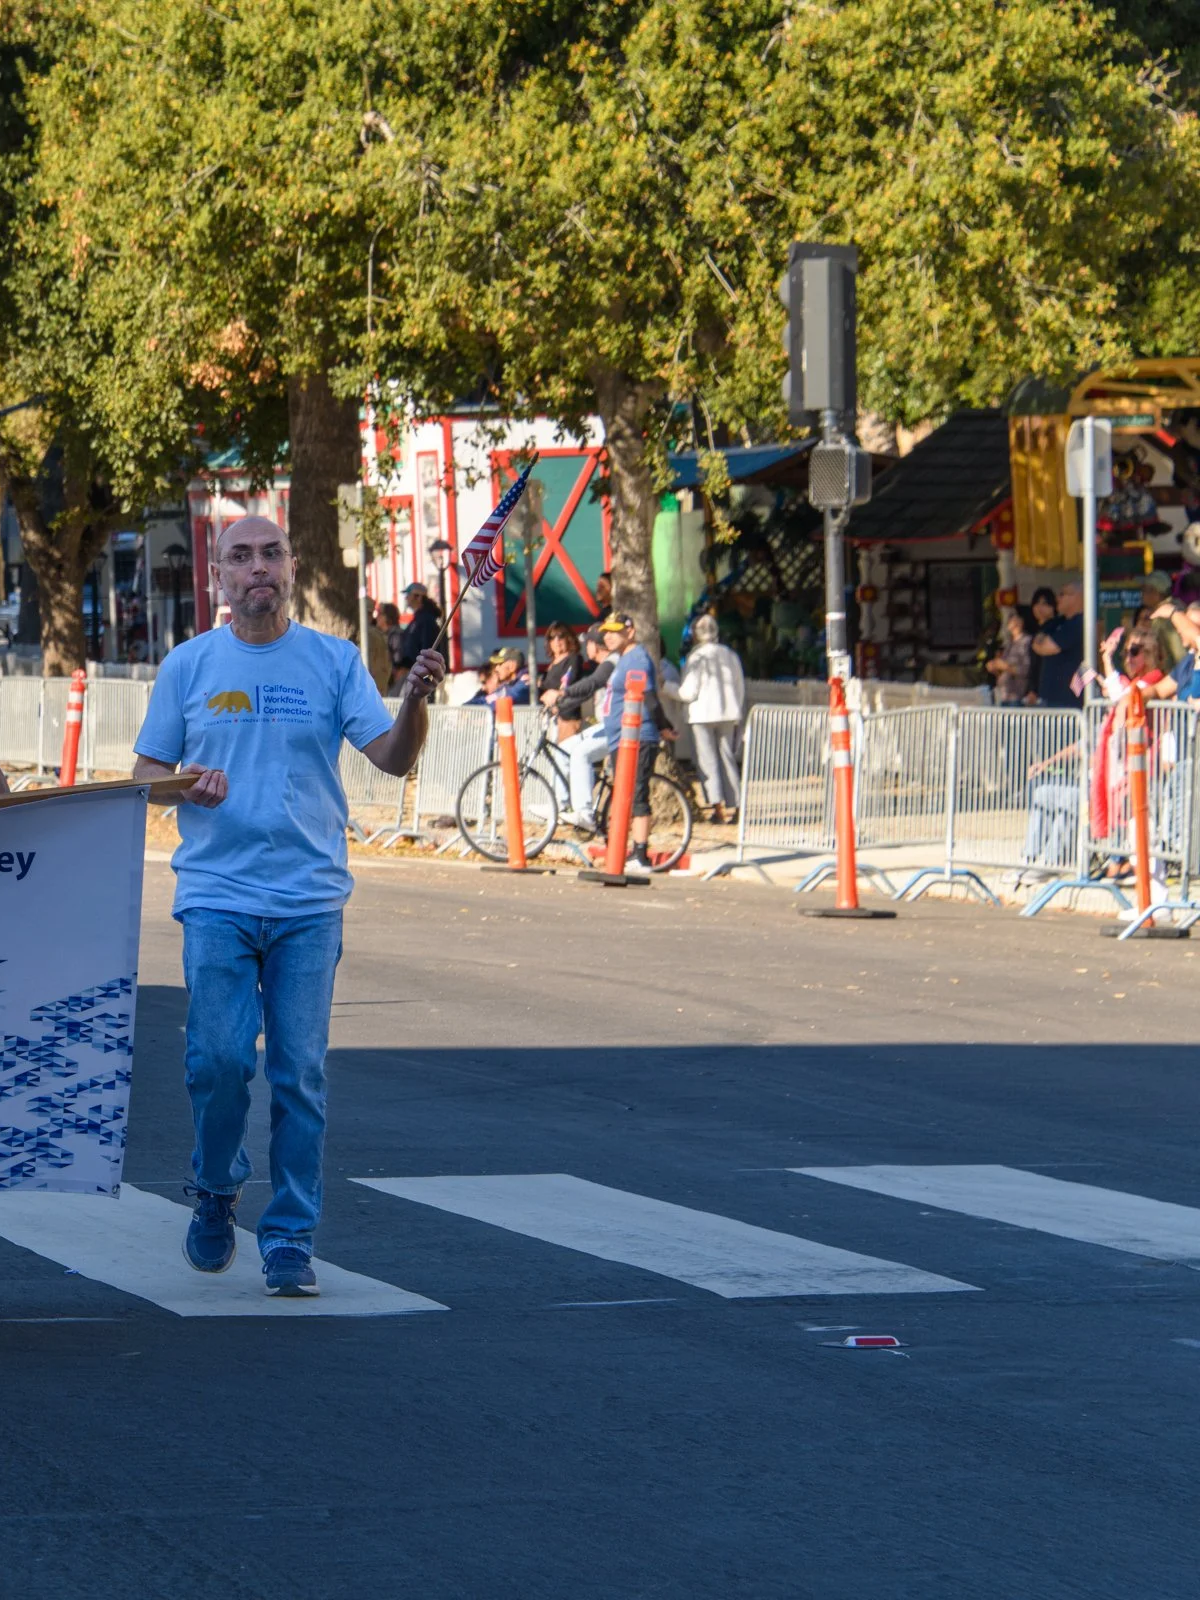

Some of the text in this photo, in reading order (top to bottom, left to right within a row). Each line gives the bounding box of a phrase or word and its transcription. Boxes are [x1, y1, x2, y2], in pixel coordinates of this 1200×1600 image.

[263, 685, 304, 695] California
[263, 695, 308, 706] Workforce
[263, 706, 313, 716] Connection
